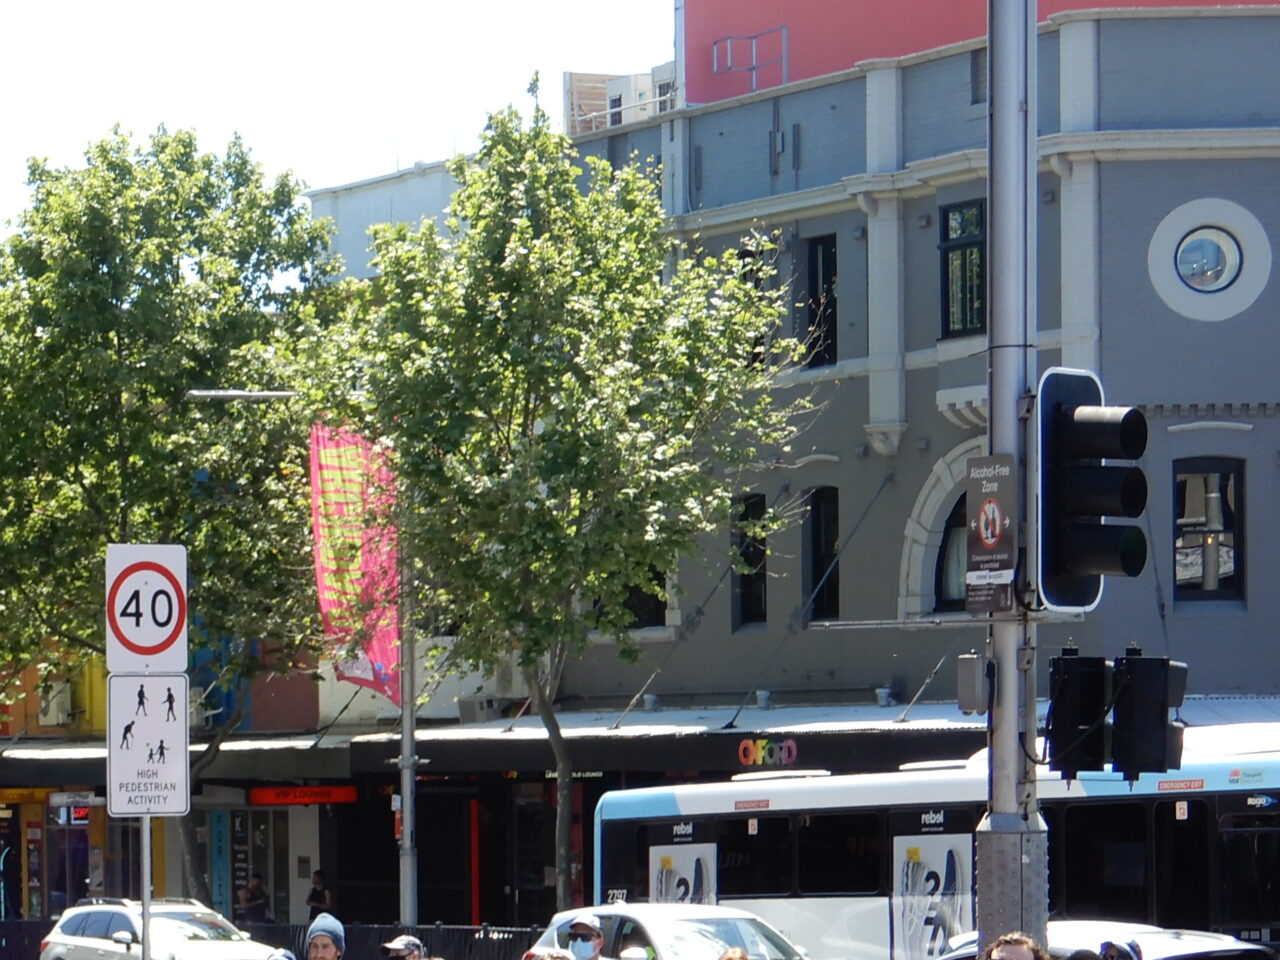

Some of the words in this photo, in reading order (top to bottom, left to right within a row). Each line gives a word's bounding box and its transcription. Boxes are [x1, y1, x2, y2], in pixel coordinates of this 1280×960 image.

[970, 464, 1010, 479] Alcohol-Free
[981, 481, 998, 493] Zone
[119, 589, 173, 628] 40
[137, 769, 159, 779] HIGH
[118, 782, 176, 793] PEDESTRIAN
[127, 795, 168, 805] ACTIVITY
[607, 889, 627, 904] 2797
